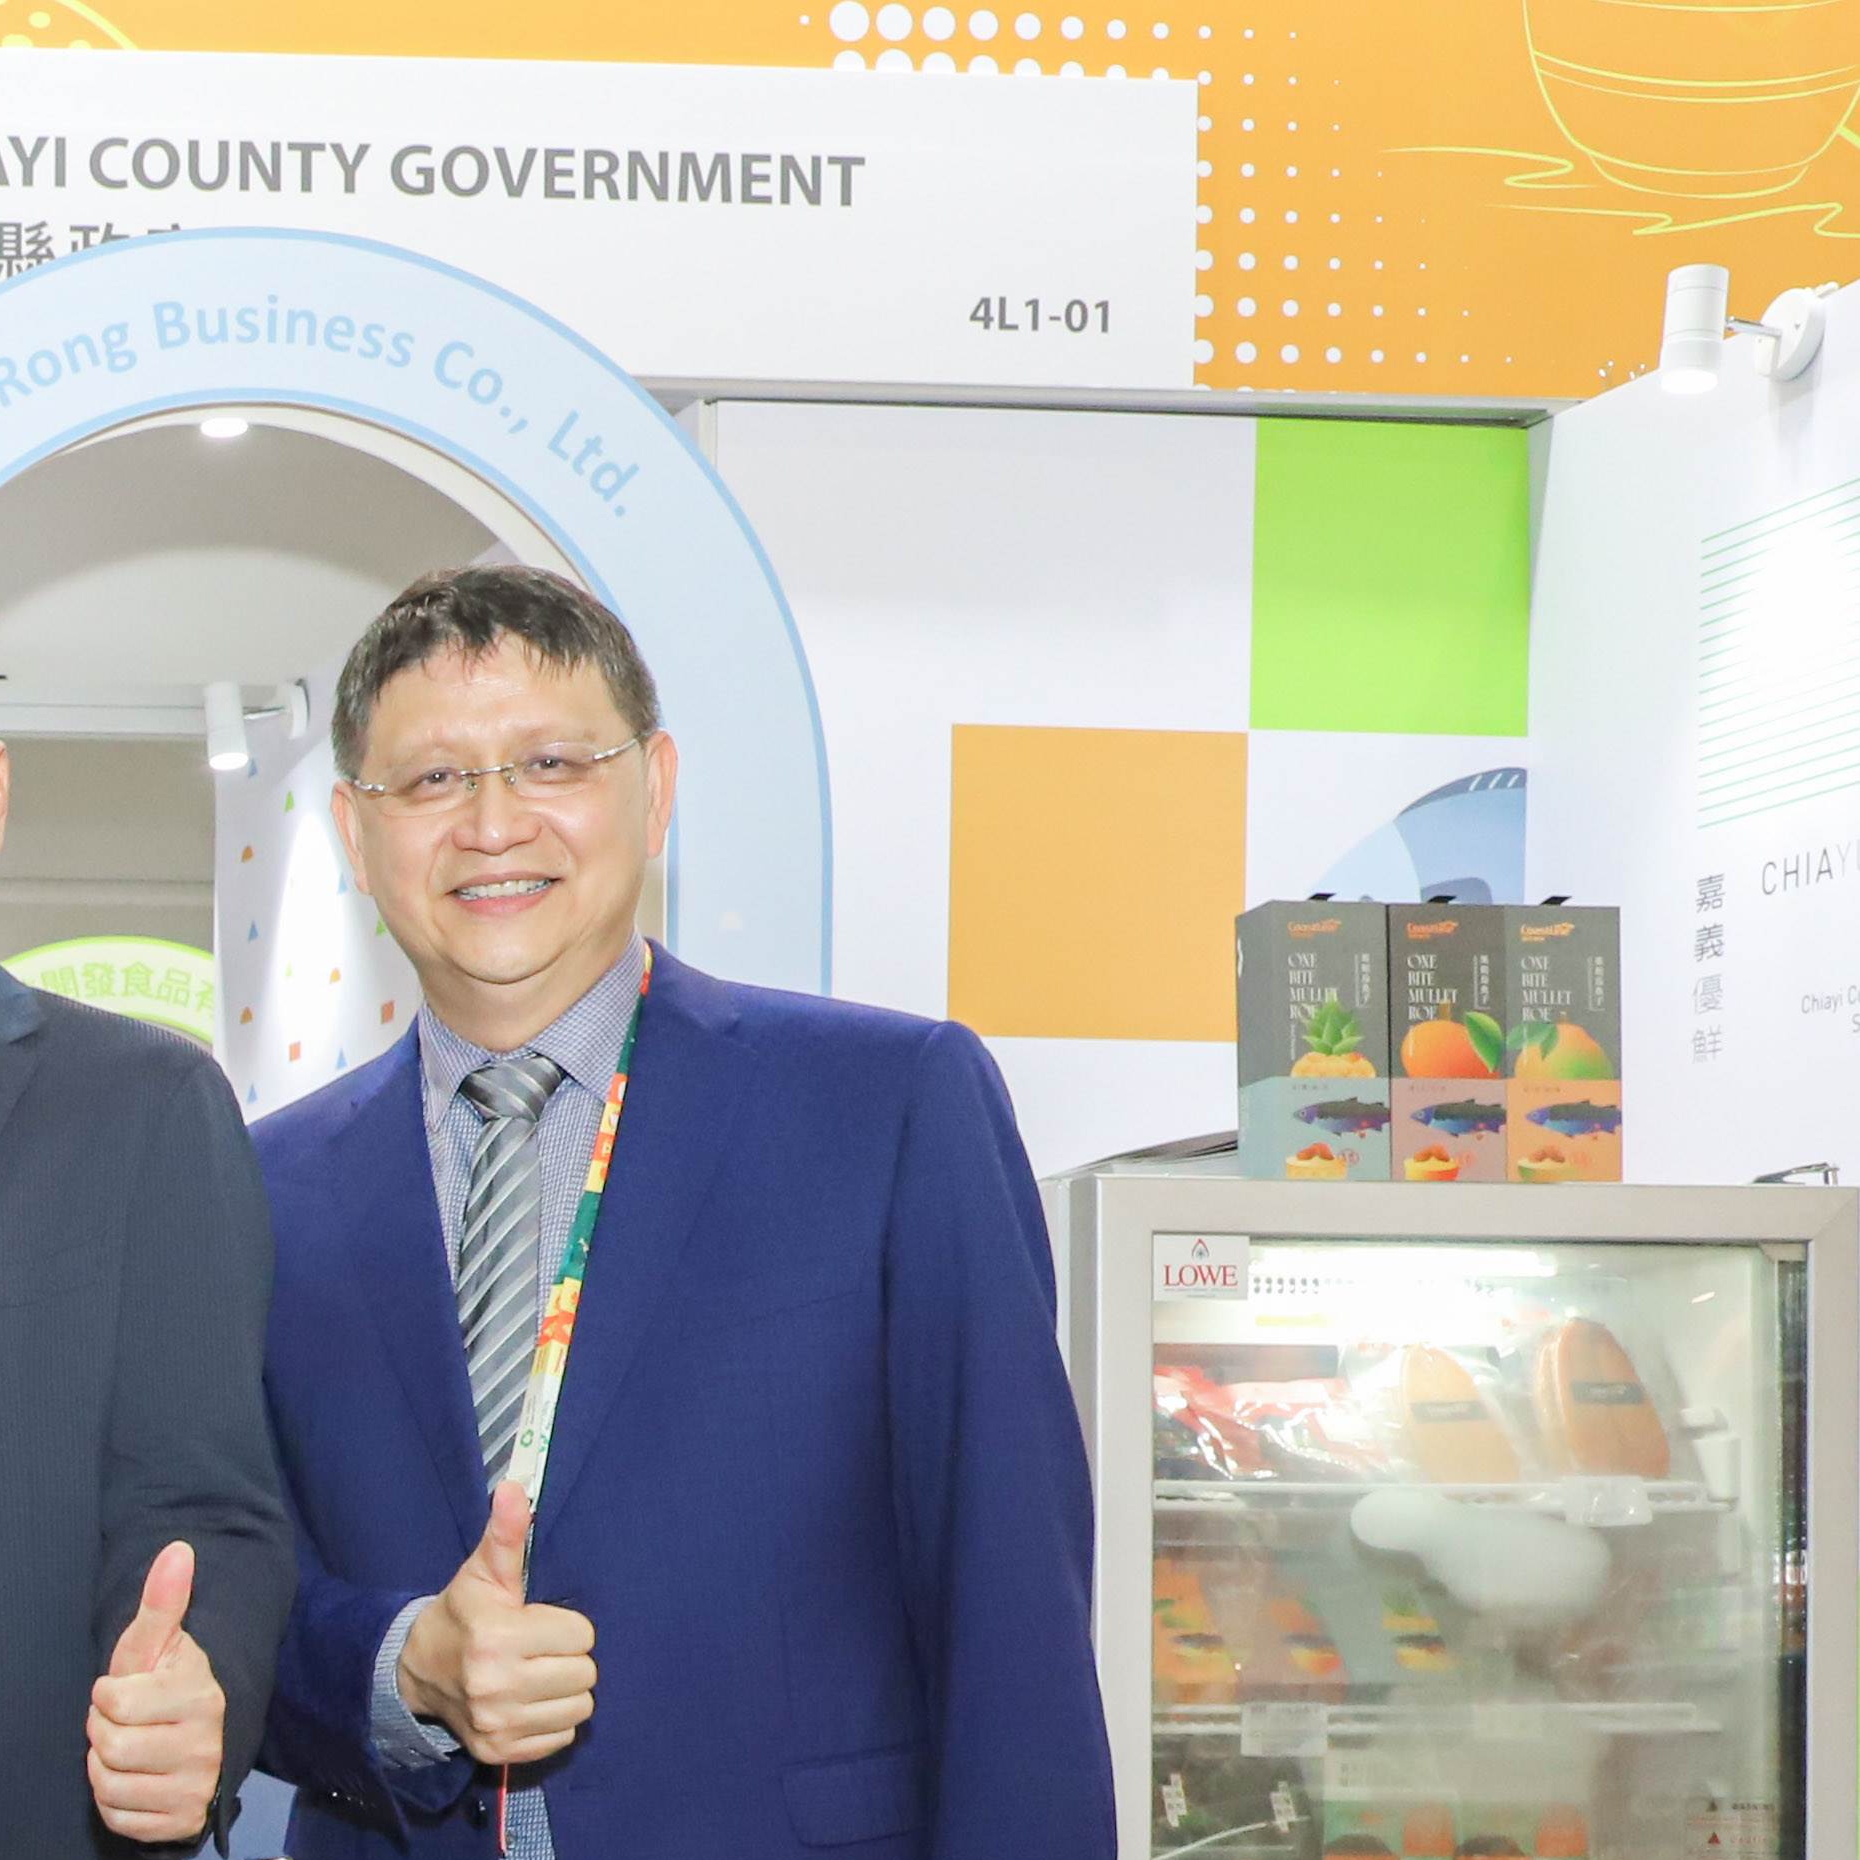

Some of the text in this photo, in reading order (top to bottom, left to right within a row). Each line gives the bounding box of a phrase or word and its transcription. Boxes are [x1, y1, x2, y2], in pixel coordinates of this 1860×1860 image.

[88, 136, 370, 195] COUNTY
[389, 143, 866, 209] GOVERNMENT
[968, 295, 1112, 334] 4L1-01
[153, 295, 417, 369] Business
[432, 341, 530, 436] Co.,
[547, 410, 641, 517] Ltd.
[1289, 970, 1314, 984] BITE
[1692, 872, 1726, 1065] 嘉義優鮮
[1408, 971, 1435, 986] BITE
[1522, 973, 1548, 987] BITE
[1522, 990, 1572, 1005] MULLET
[1800, 991, 1843, 1015] Chiayi
[1408, 1006, 1437, 1020] ROE
[1522, 1007, 1551, 1021] ROE
[1163, 1264, 1239, 1287] LOWE
